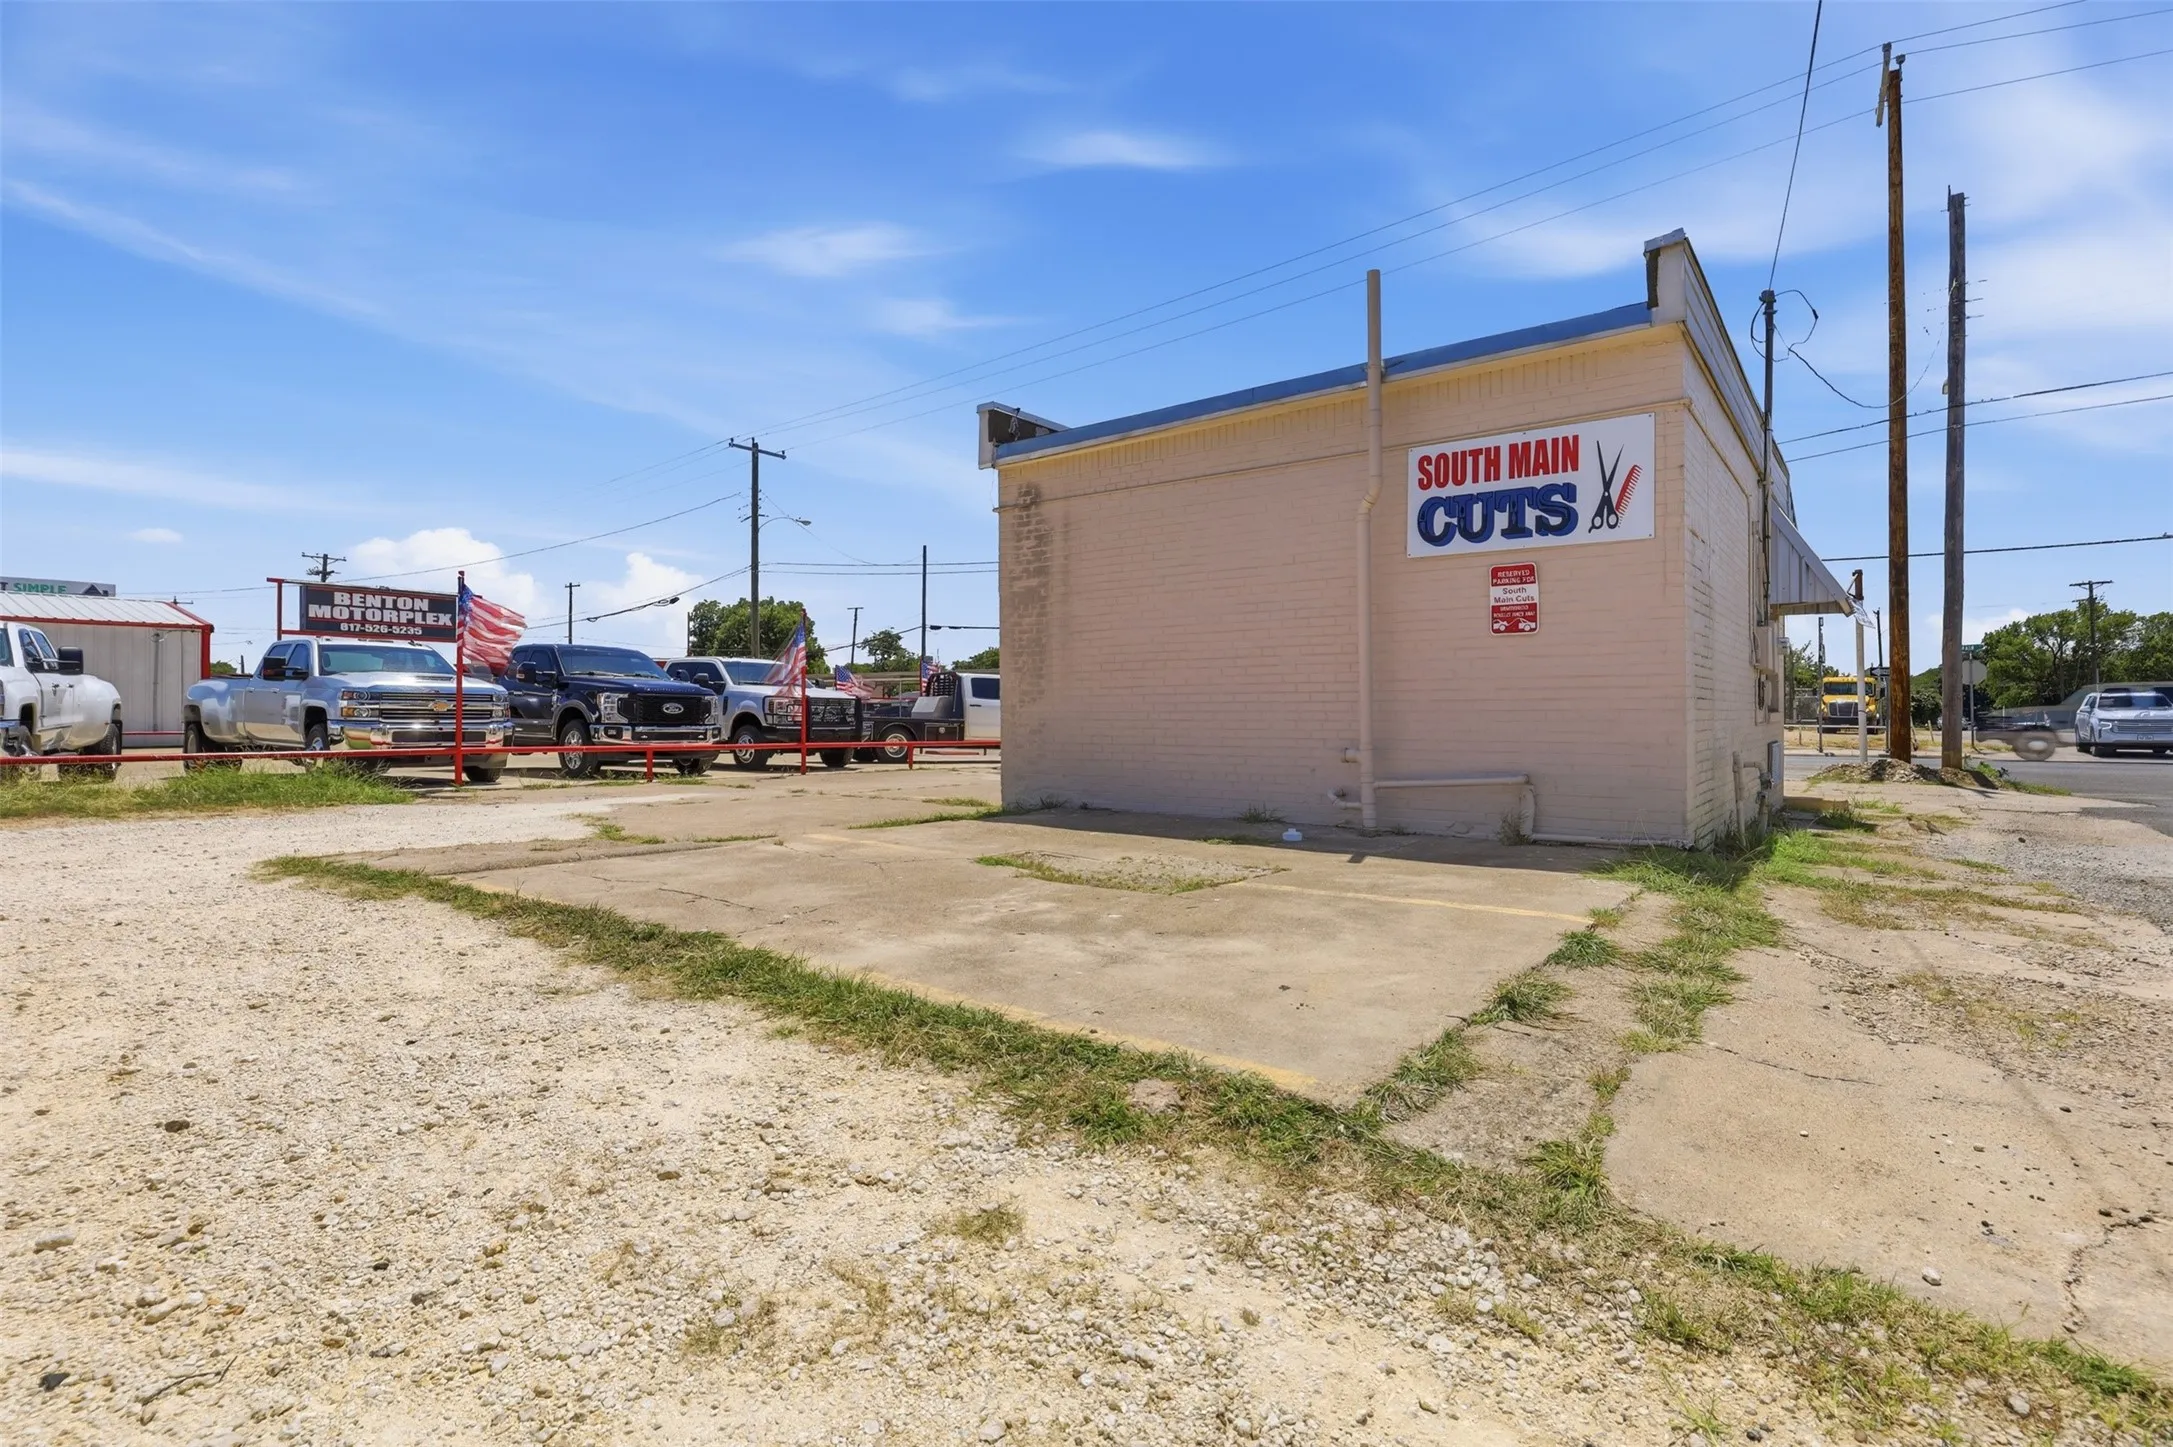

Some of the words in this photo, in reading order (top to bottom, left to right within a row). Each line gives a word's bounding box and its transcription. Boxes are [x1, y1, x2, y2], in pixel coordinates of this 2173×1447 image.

[1418, 446, 1501, 491] SOUTH
[1508, 434, 1579, 479] MAIN
[1417, 482, 1579, 547] CUTS
[14, 582, 67, 593] SIMPLE
[1502, 586, 1527, 595] South
[333, 591, 429, 612] BENTON
[308, 604, 453, 626] MOTORPLEX
